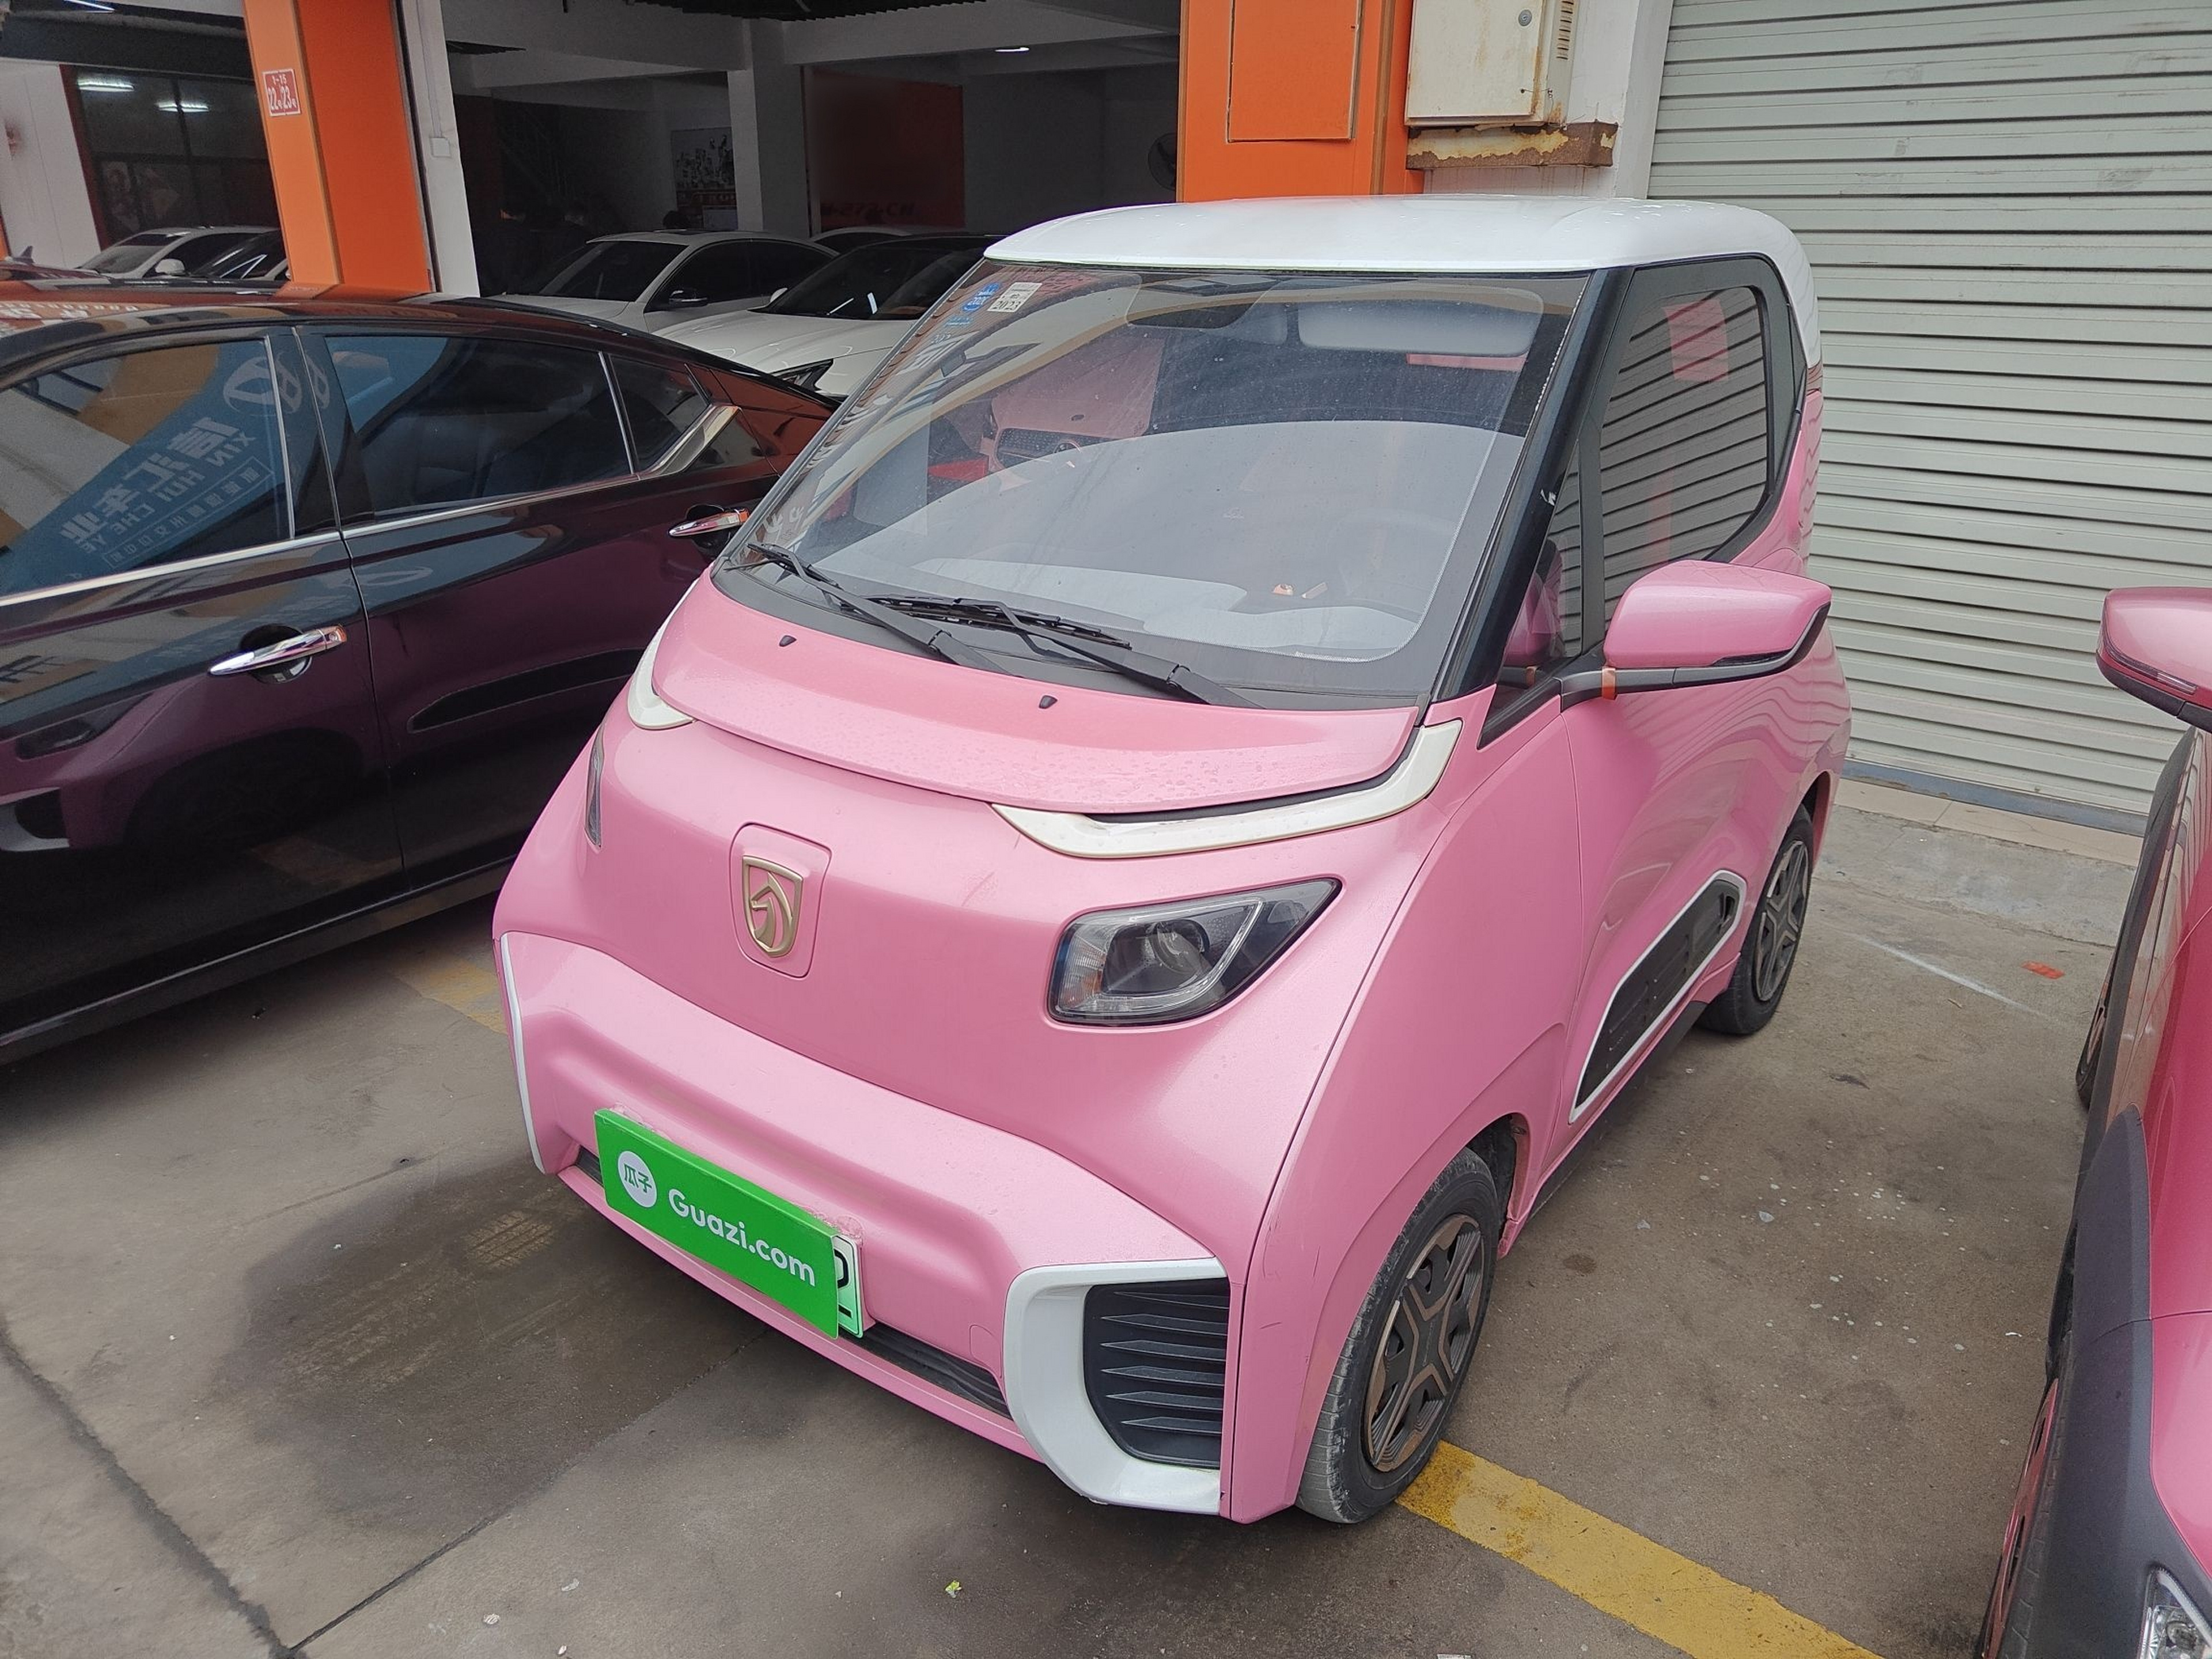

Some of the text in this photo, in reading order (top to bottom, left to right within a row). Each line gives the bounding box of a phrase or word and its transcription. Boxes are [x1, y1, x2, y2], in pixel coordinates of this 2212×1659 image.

[992, 300, 1021, 311] 2023
[624, 1164, 652, 1193] 瓜子
[668, 1188, 816, 1287] Guazi.com
